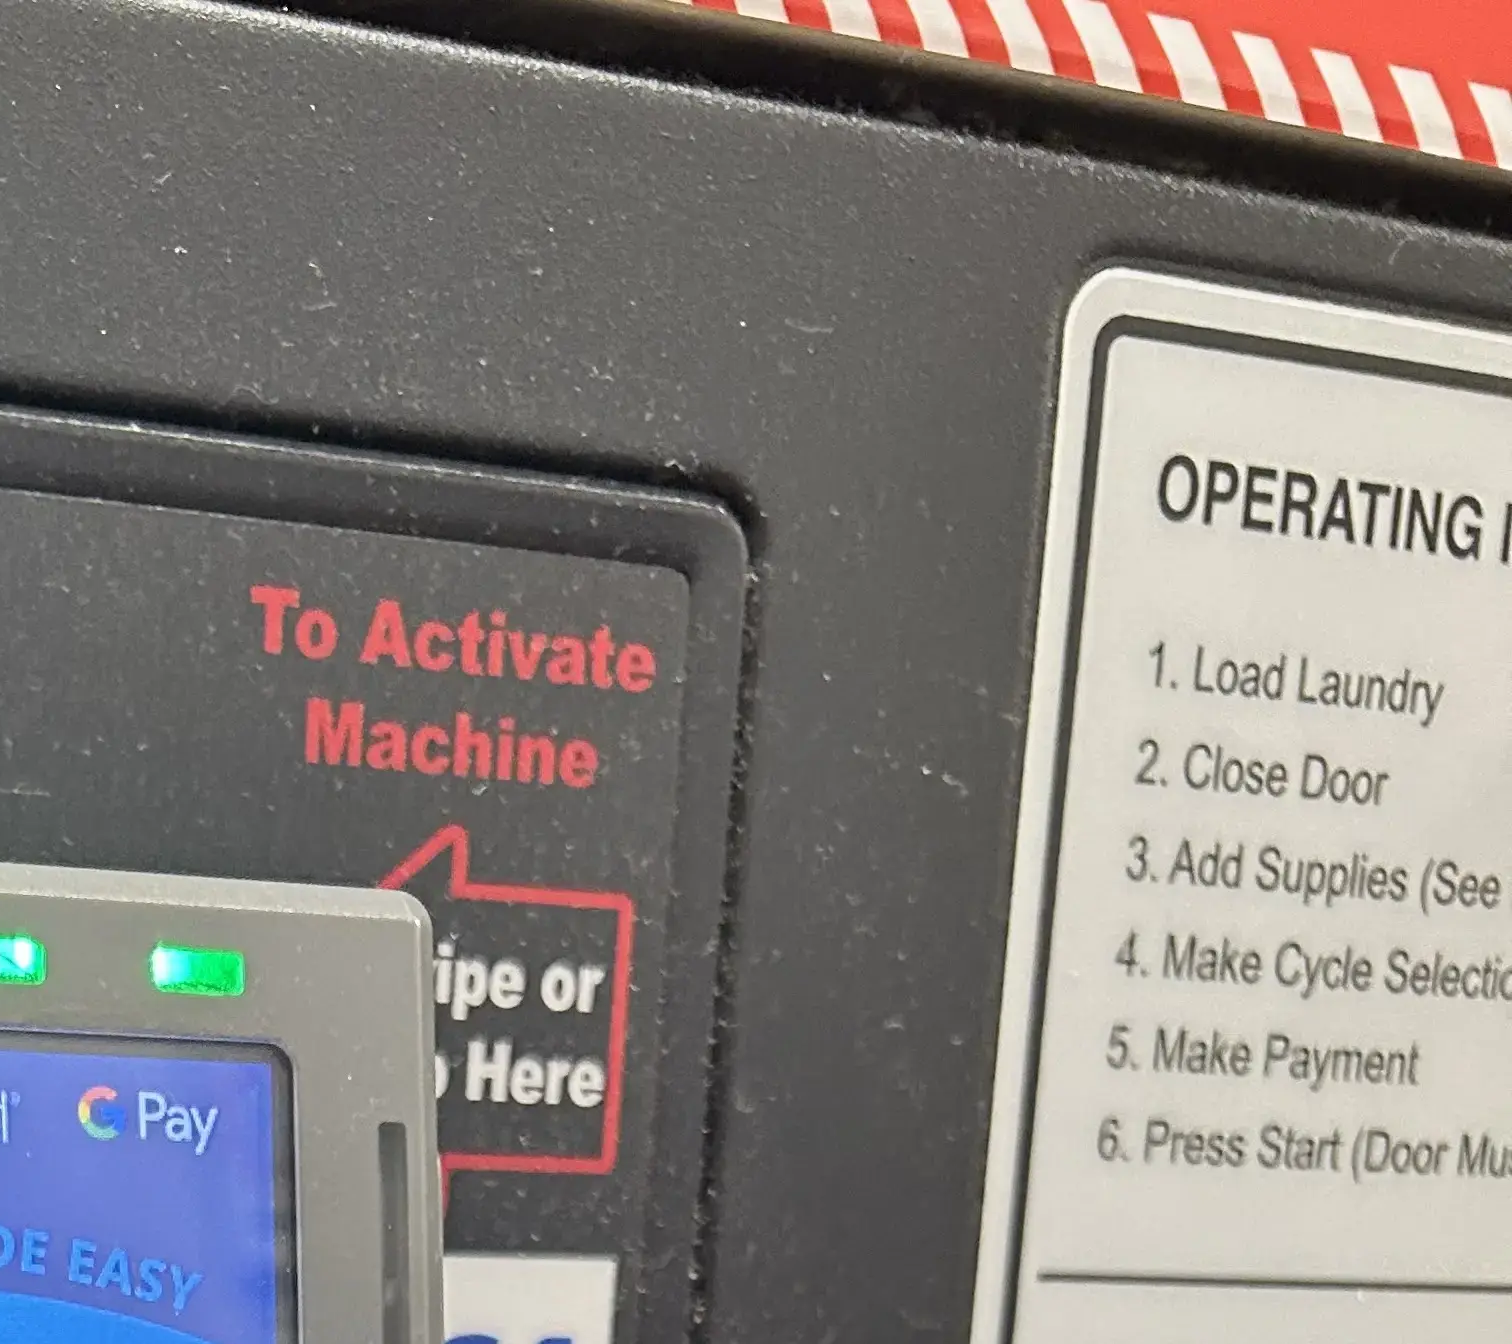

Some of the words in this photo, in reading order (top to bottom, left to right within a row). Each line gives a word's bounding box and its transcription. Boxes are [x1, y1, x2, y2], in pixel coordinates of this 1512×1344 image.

[1158, 454, 1483, 560] OPERATING
[250, 585, 338, 659] To
[360, 598, 657, 694] Activate
[1149, 641, 1178, 690] 1.
[1194, 646, 1286, 701] Load
[1298, 657, 1444, 727] Laundry
[304, 697, 599, 788] Machine
[1135, 739, 1168, 788] 2.
[1184, 744, 1288, 795] Close
[1301, 754, 1389, 806] Door
[1126, 836, 1156, 883] 3.
[1168, 840, 1244, 889] Add
[1256, 845, 1408, 907] Supplies
[1421, 857, 1501, 915] (See
[433, 942, 526, 1021] ipe
[541, 958, 607, 1014] or
[1115, 931, 1148, 979] 4.
[1162, 933, 1261, 985] Make
[1274, 941, 1372, 1000] Cycle
[465, 1040, 604, 1108] Here
[1106, 1024, 1140, 1072] 5.
[1153, 1025, 1251, 1077] Make
[1264, 1034, 1419, 1092] Payment
[137, 1091, 219, 1156] Pay
[1097, 1115, 1130, 1164] 6.
[1144, 1120, 1245, 1168] Press
[1257, 1125, 1343, 1172] Start
[1352, 1129, 1449, 1183] (Door
[68, 1239, 204, 1315] EASY
